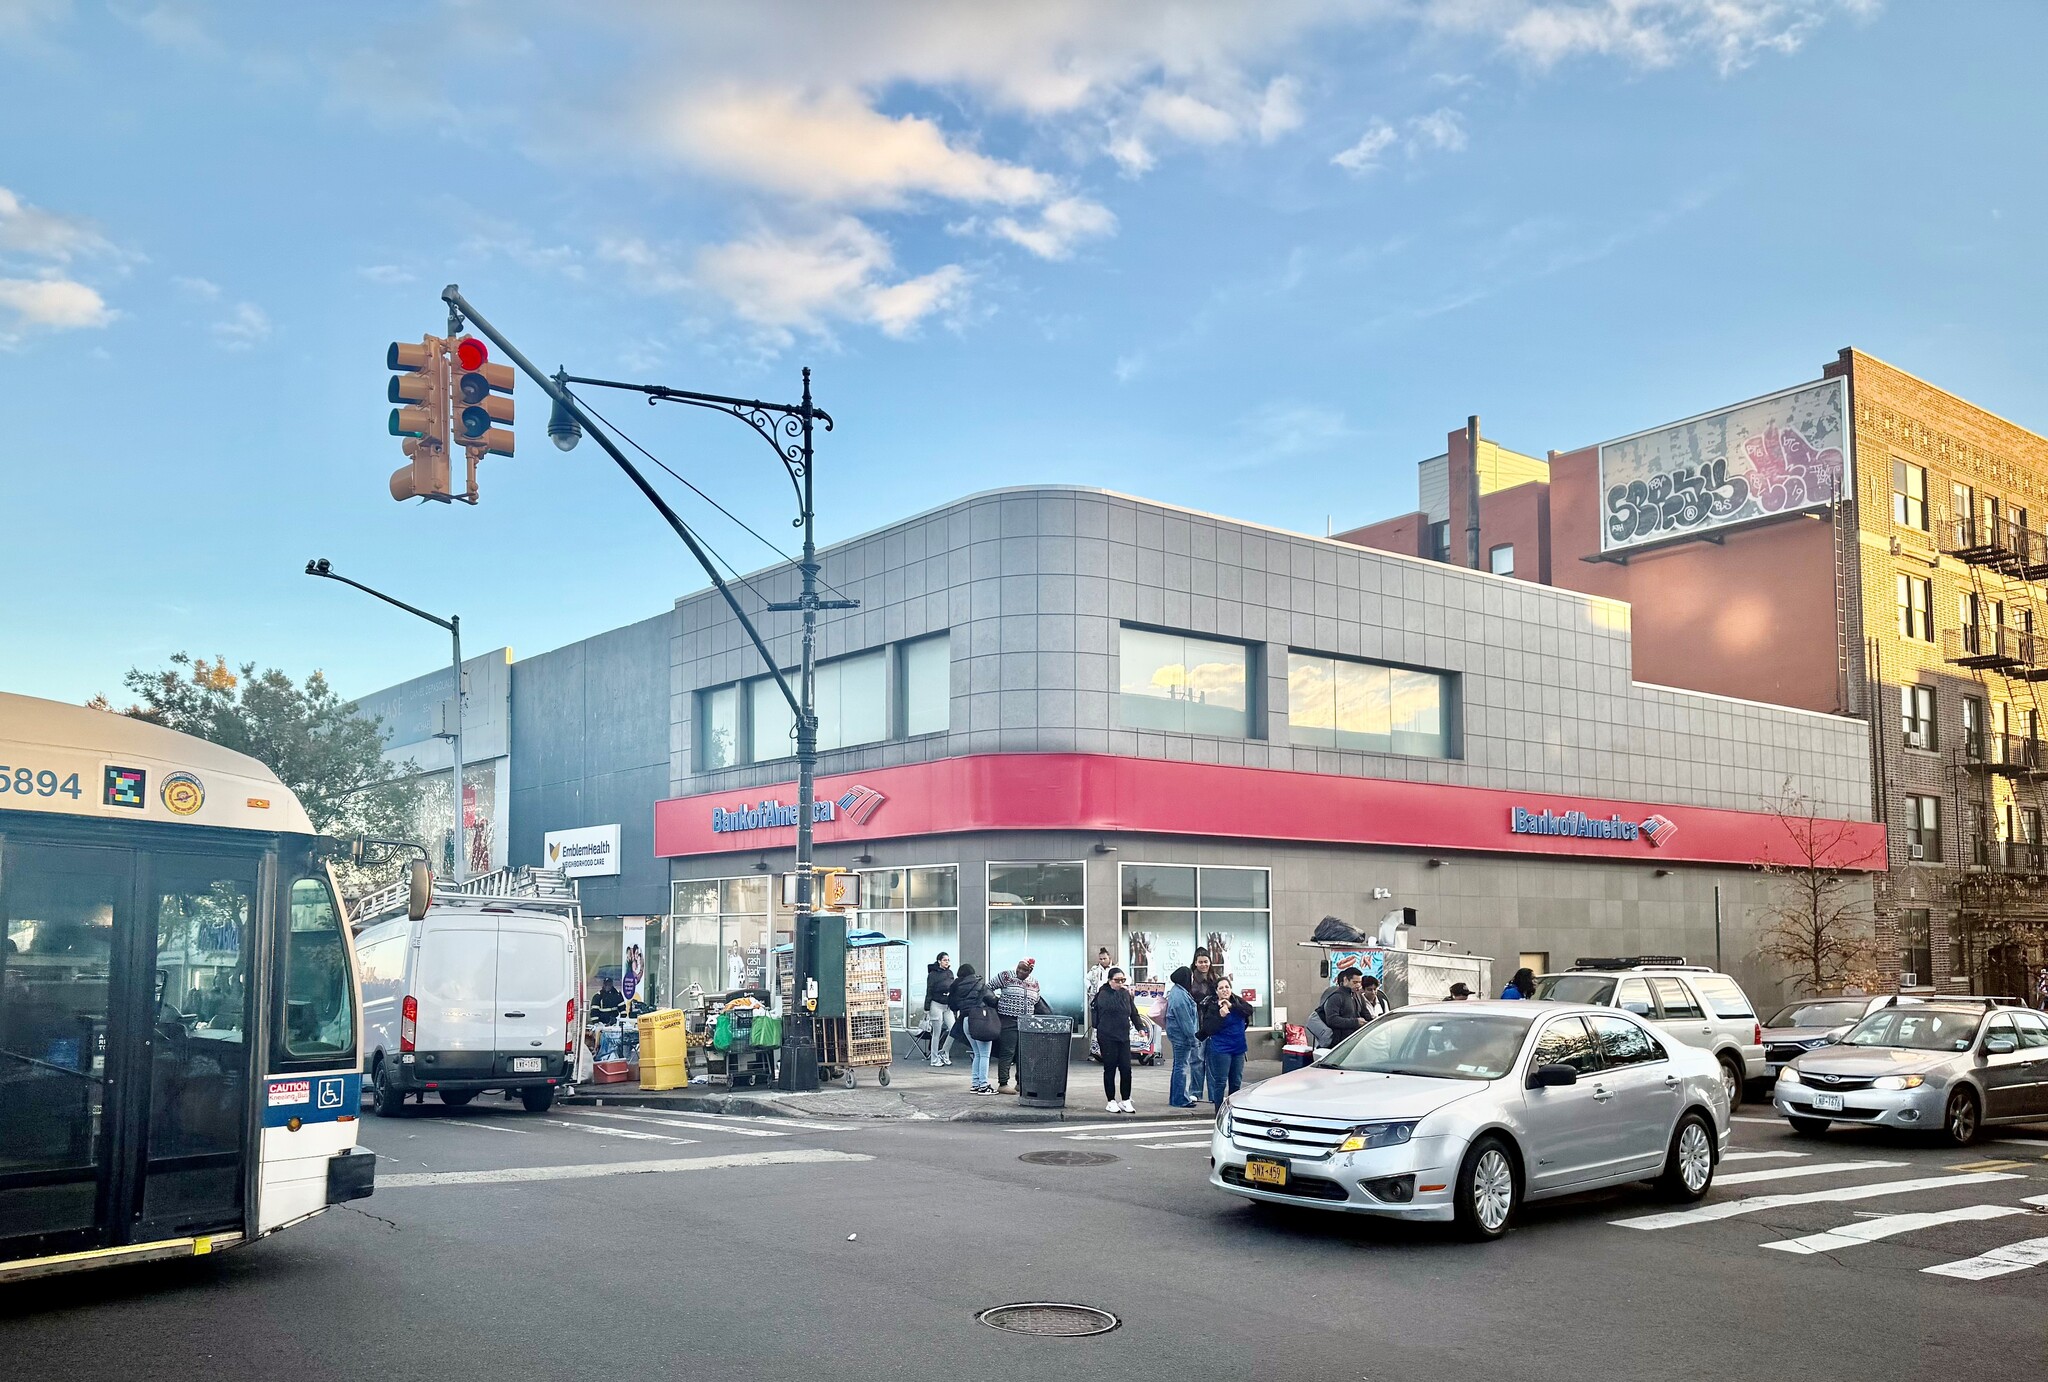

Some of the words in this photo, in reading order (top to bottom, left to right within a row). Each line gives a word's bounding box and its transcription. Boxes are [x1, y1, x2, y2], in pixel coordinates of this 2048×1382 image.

[562, 840, 611, 858] EmblemHealth
[594, 858, 605, 866] CARE
[746, 955, 761, 966] cash
[746, 965, 761, 977] back
[269, 1081, 310, 1092] CAUTION
